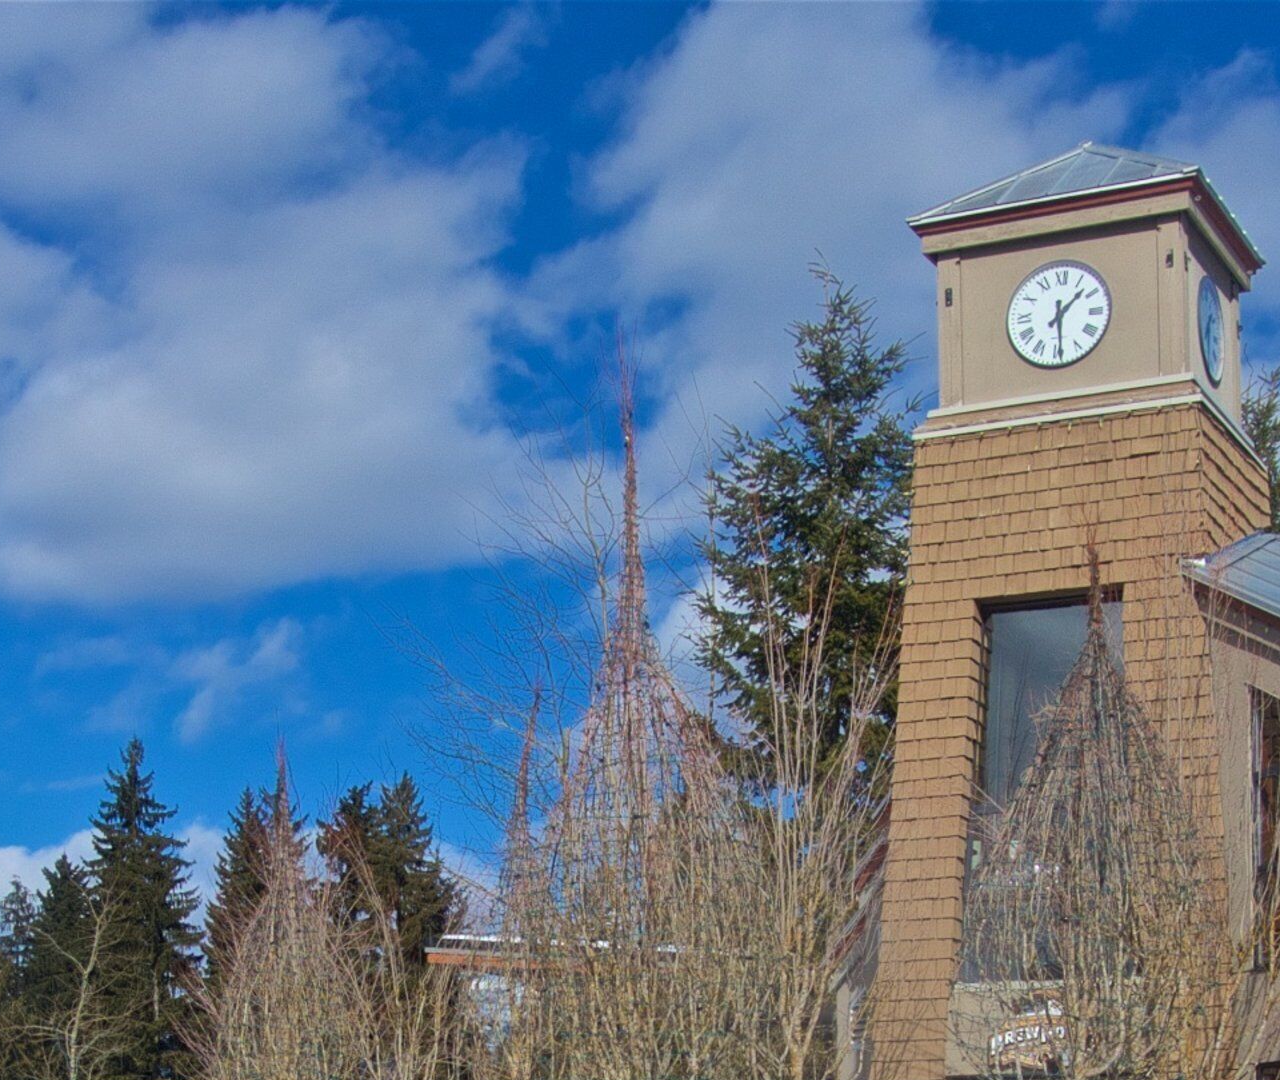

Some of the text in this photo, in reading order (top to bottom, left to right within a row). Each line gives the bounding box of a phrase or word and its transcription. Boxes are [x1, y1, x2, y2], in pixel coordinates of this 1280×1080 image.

[1036, 276, 1051, 292] XI
[1055, 270, 1068, 286] XII
[1075, 274, 1084, 288] I
[1022, 293, 1037, 306] X
[1085, 287, 1099, 299] II
[1017, 312, 1032, 325] IX
[1032, 338, 1046, 357] VII
[1073, 339, 1083, 353] V
